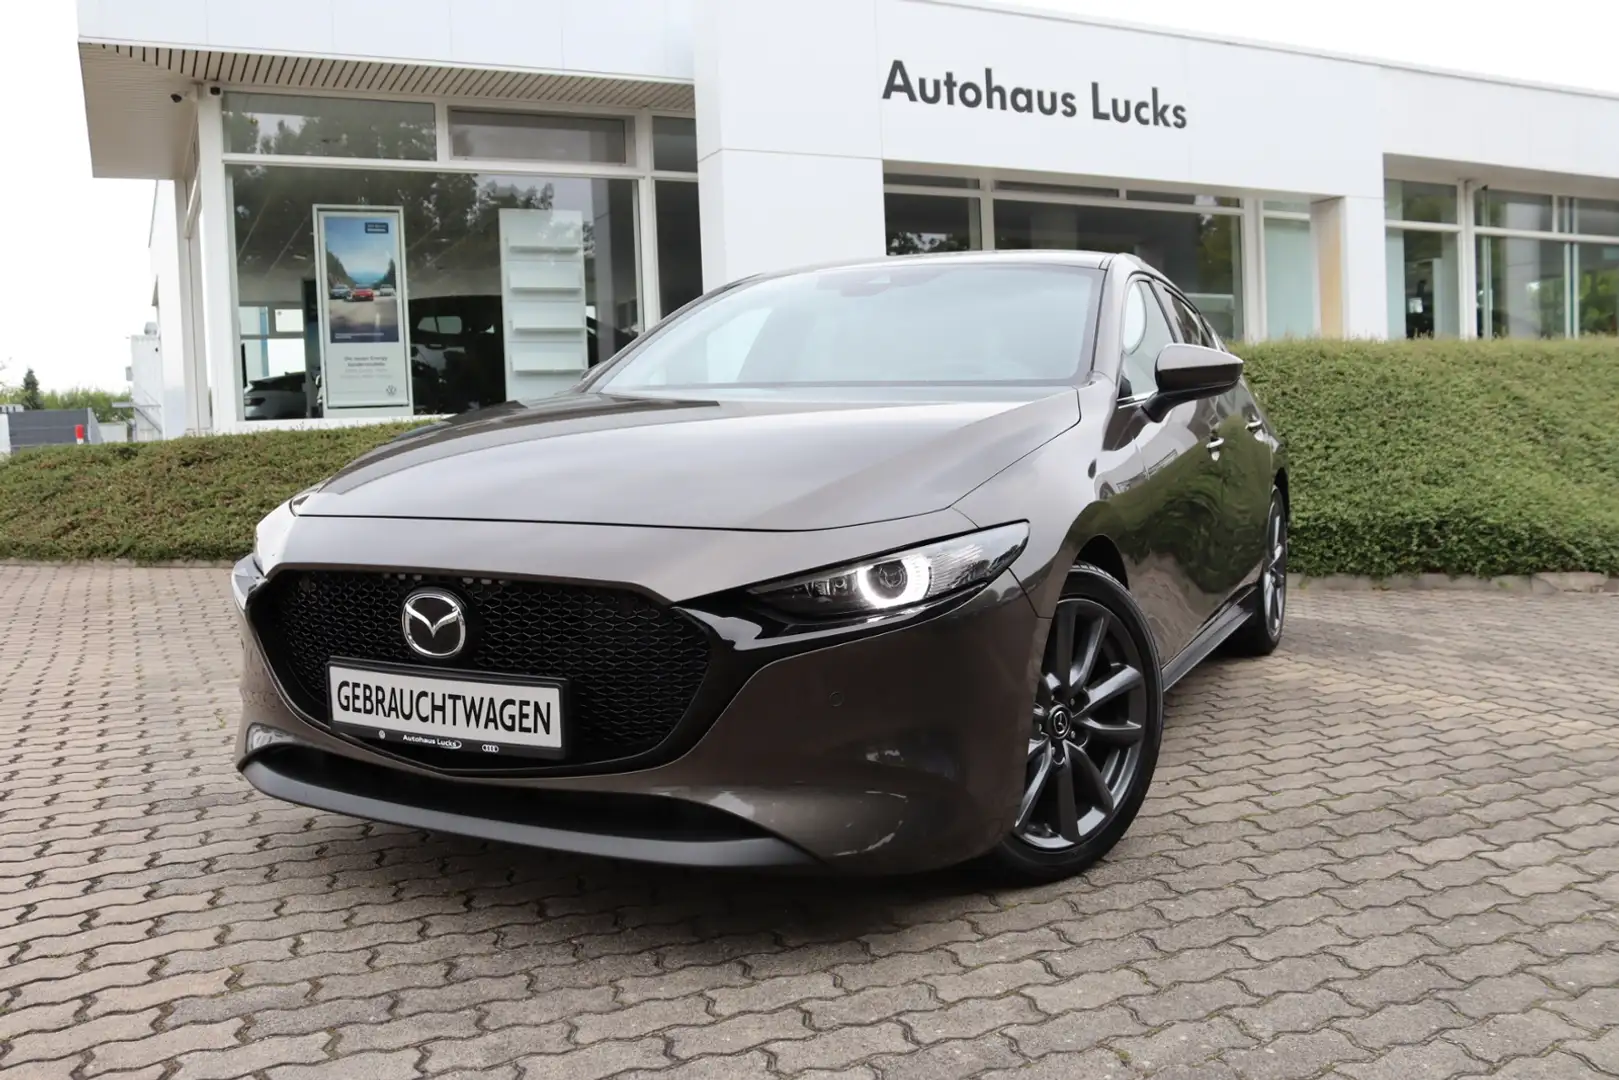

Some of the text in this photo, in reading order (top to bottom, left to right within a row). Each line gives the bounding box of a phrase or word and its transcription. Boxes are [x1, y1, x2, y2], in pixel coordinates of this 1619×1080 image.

[882, 59, 1188, 129] Autohaus Lucks
[337, 680, 551, 735] GEBRAUCHTWAGEN
[403, 734, 457, 748] Autohaus Lucks
